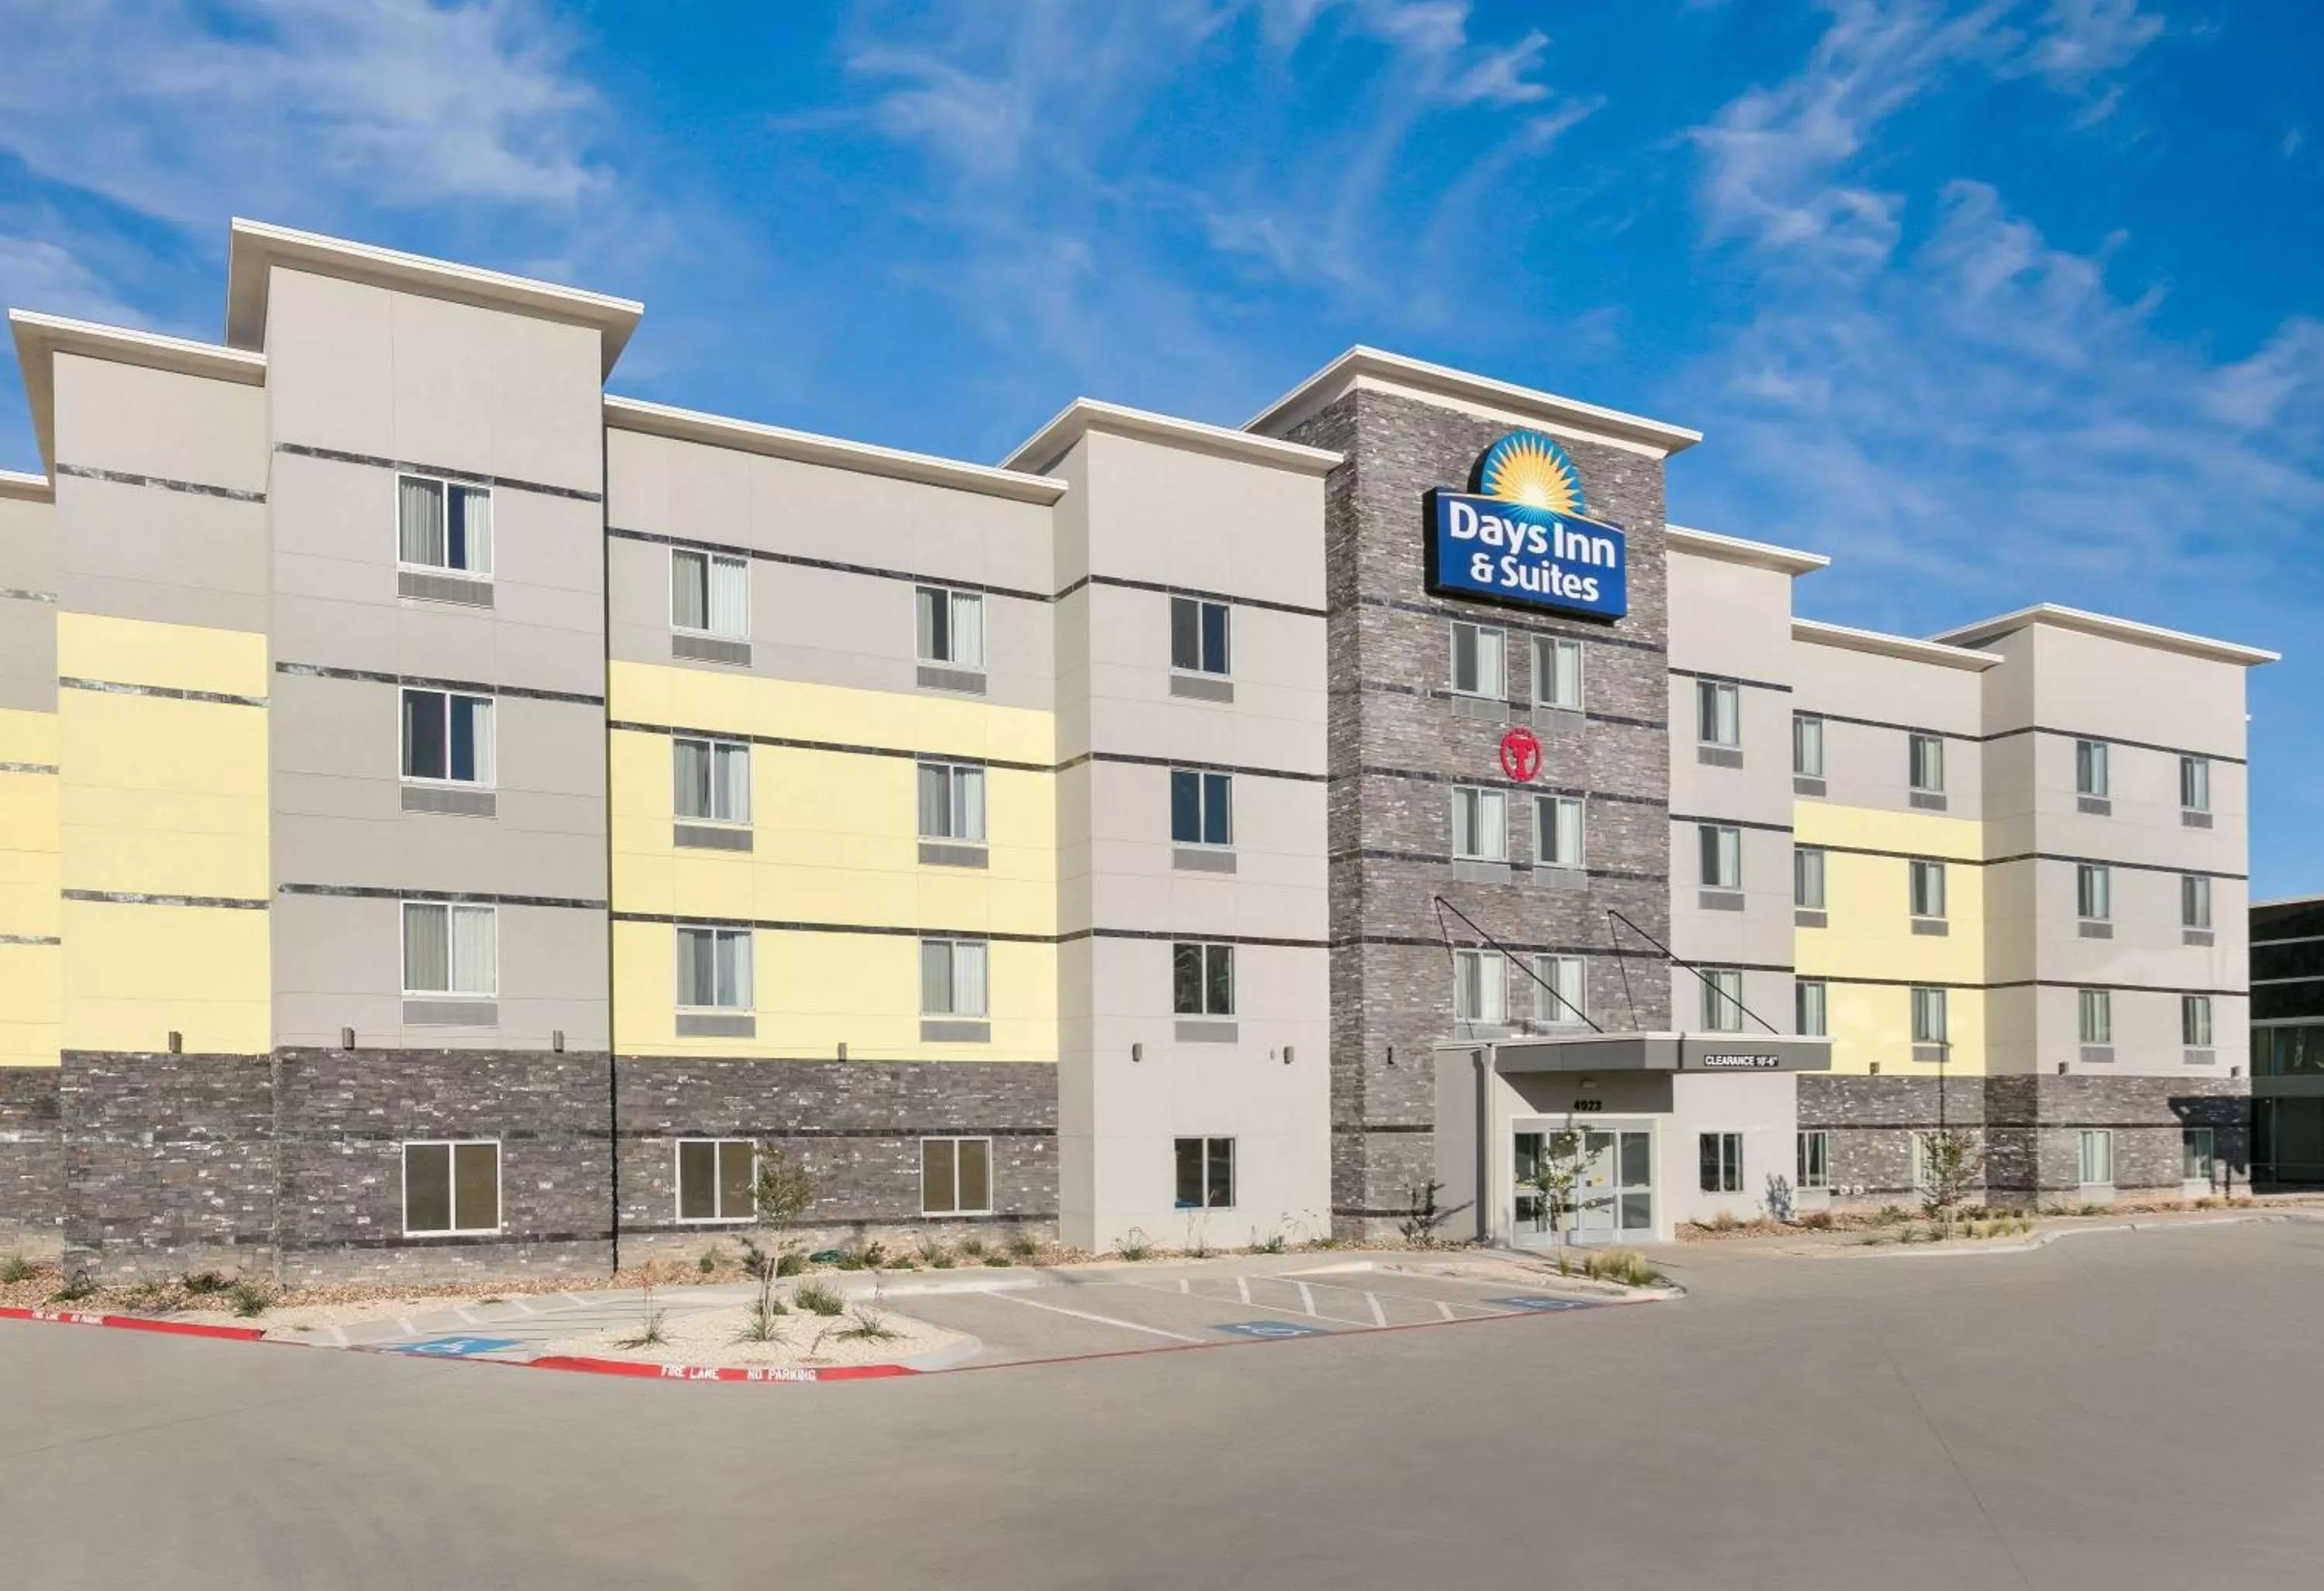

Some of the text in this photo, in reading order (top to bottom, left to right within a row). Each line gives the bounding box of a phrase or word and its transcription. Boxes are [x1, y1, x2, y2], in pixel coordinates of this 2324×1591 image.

[1449, 500, 1615, 568] Days Inn
[1470, 552, 1600, 602] & Suites
[1705, 1056, 1755, 1065] CLEARANCE
[1573, 1100, 1602, 1111] 4923
[661, 1364, 816, 1381] FIRE LANE NO PARKING
